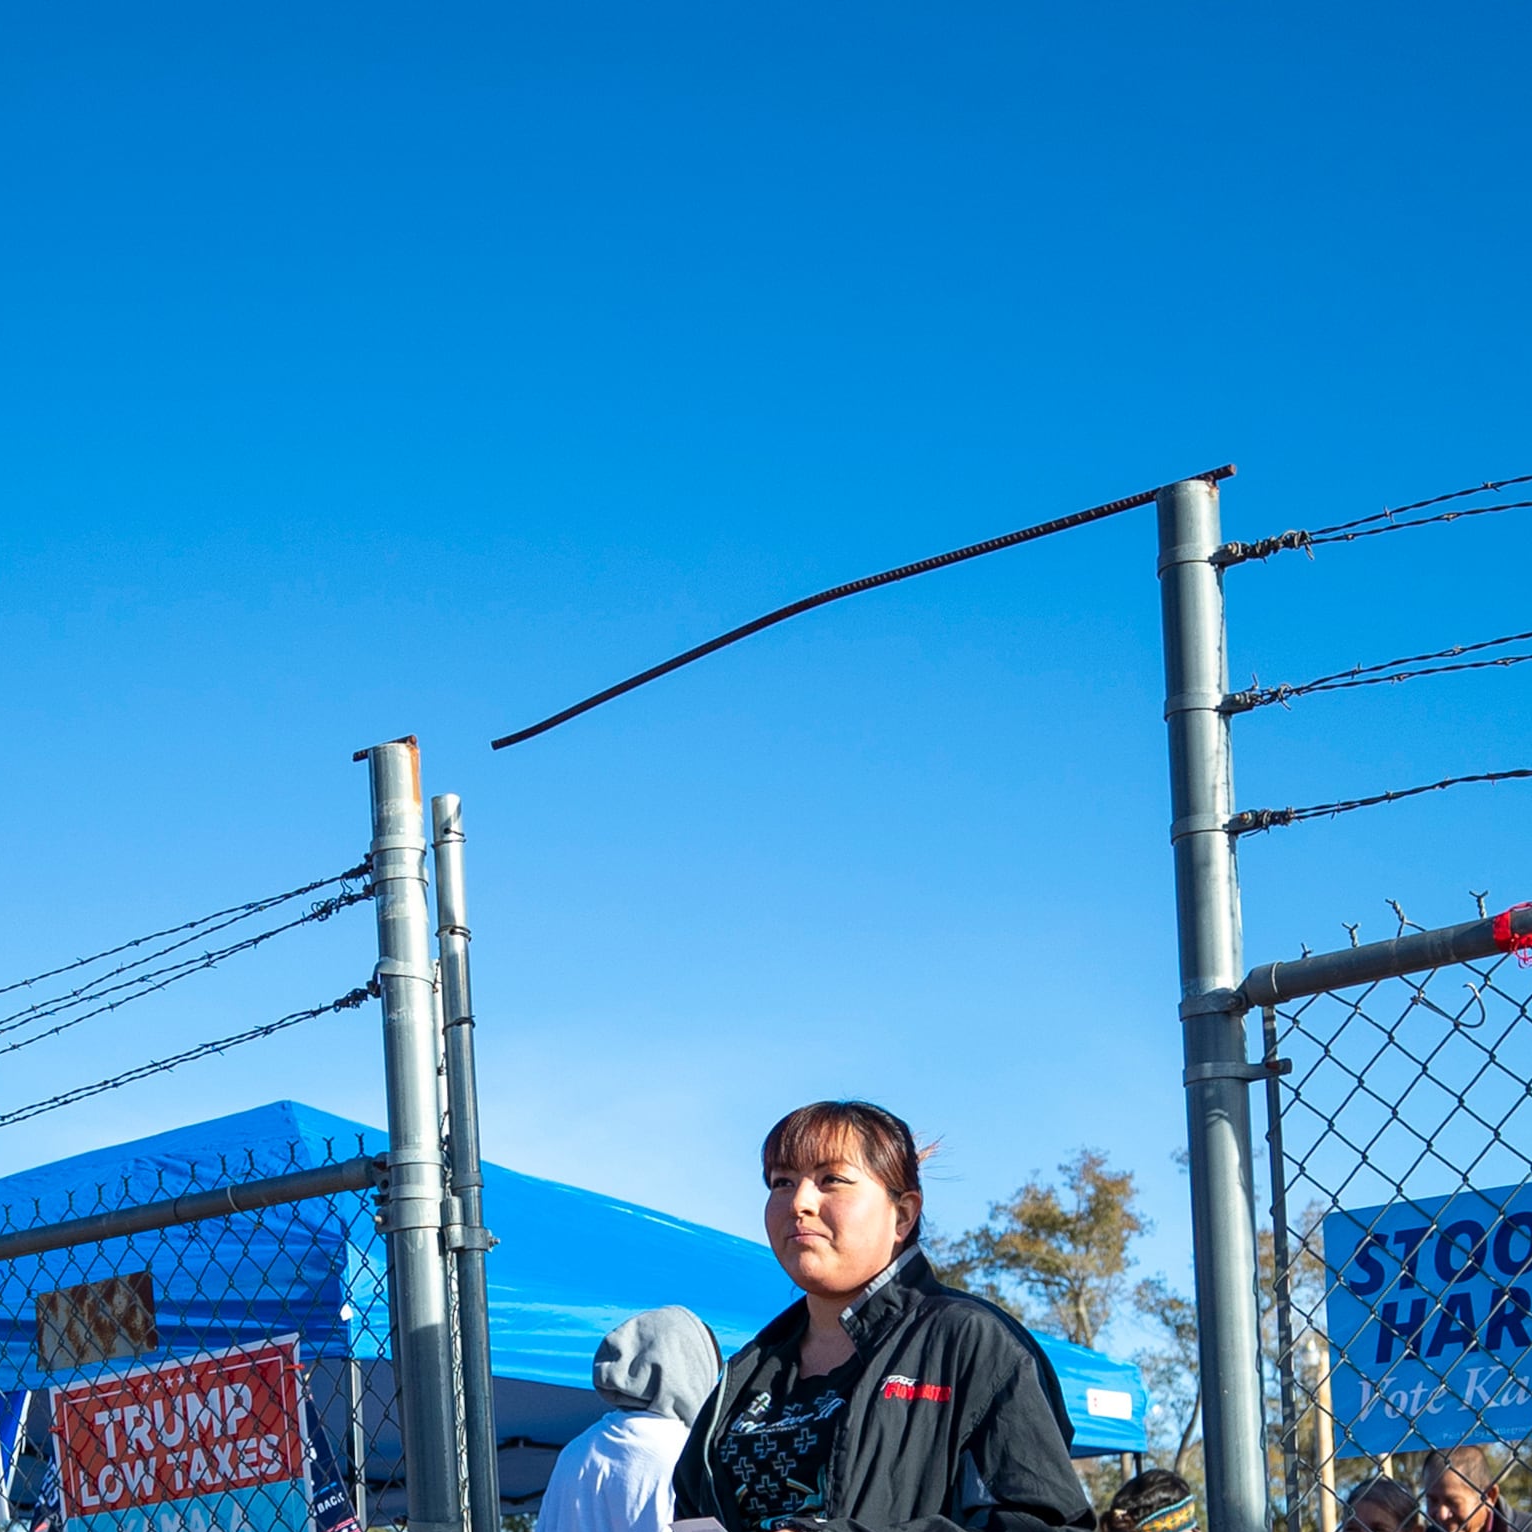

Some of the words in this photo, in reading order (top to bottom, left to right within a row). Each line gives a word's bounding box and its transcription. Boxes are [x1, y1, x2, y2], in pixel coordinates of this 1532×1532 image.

[95, 1383, 252, 1458] TRUMP
[1358, 1379, 1446, 1424] Vote
[79, 1457, 156, 1507] LOW
[167, 1434, 281, 1491] TAXES
